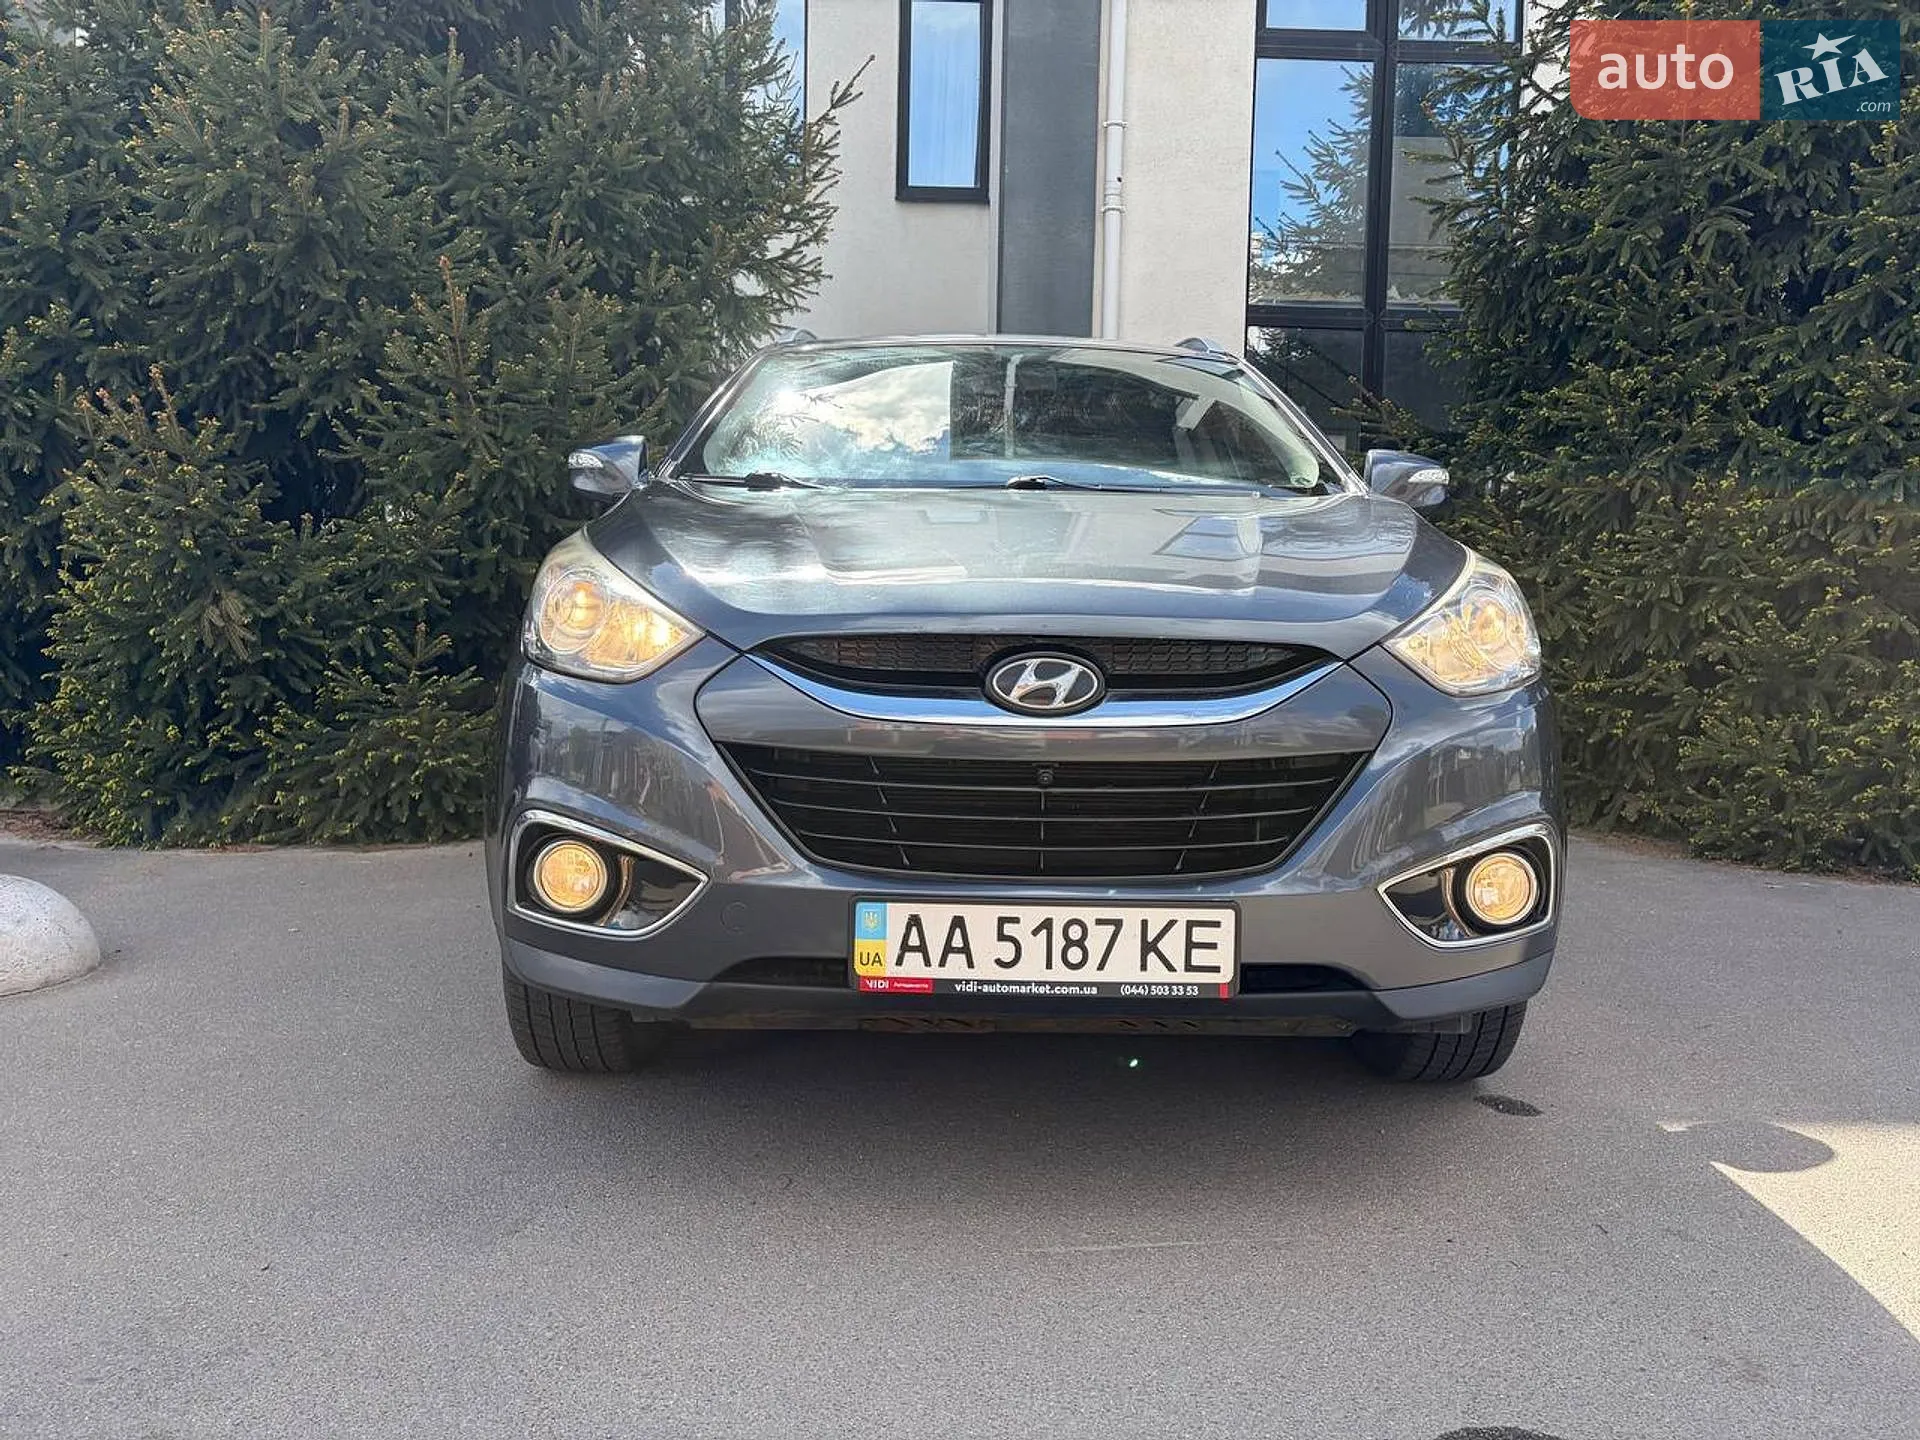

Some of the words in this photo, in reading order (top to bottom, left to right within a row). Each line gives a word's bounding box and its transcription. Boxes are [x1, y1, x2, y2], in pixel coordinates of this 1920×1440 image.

[895, 914, 975, 969] AA
[994, 916, 1124, 972] 5187
[1139, 918, 1222, 974] KE
[859, 952, 883, 967] UA
[865, 979, 889, 989] VIDI
[954, 980, 1098, 995] vidi-automarket.com.ua
[1120, 984, 1149, 996] (044)
[1150, 985, 1170, 996] 503
[1171, 985, 1185, 996] 33
[1185, 985, 1199, 996] 53
